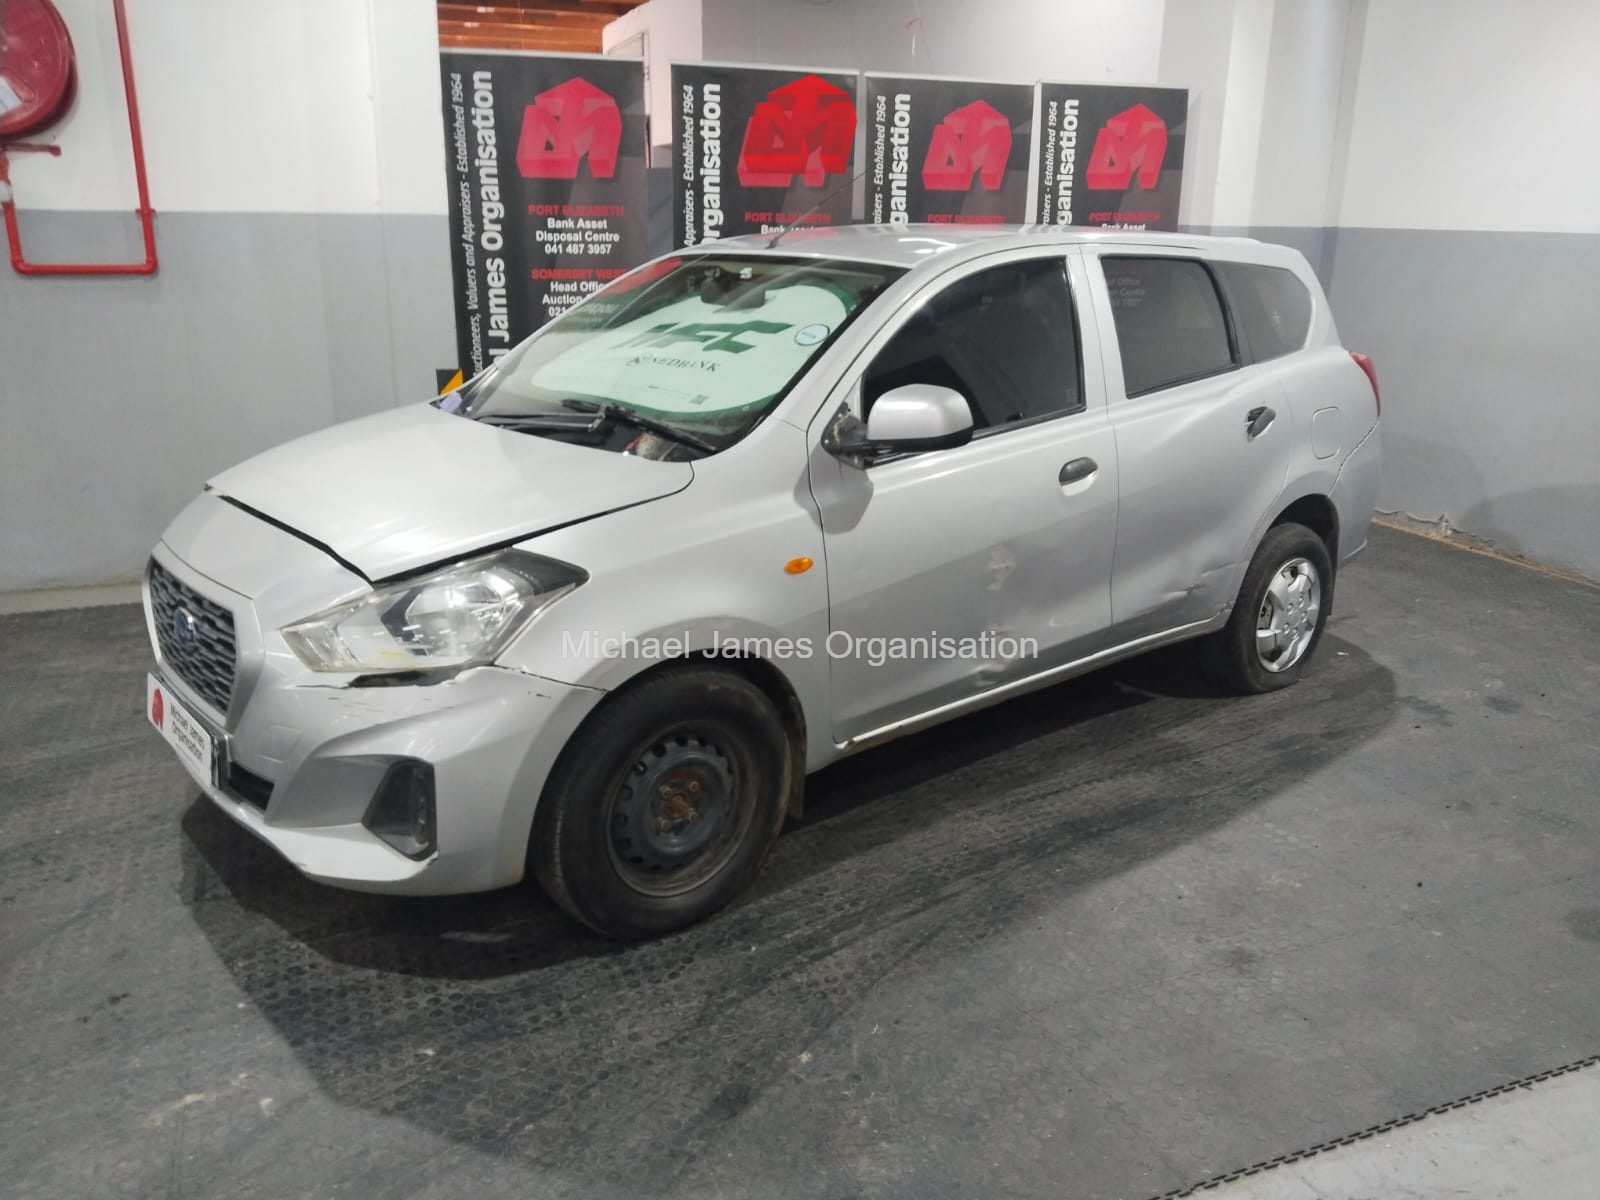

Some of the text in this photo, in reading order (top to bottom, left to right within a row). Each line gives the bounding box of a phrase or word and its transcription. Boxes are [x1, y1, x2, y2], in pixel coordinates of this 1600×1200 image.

[450, 72, 463, 103] 1964
[682, 84, 694, 114] 1964
[876, 95, 887, 122] 1964
[1048, 100, 1058, 126] 1964
[452, 104, 469, 173] Established
[682, 115, 695, 181] Established
[471, 70, 505, 251] Organisation
[874, 124, 886, 185] Established
[889, 93, 911, 225] ganisation
[1044, 128, 1056, 186] Established
[1056, 99, 1079, 225] ganisation
[459, 181, 476, 243] Appraisers
[528, 204, 559, 216] PORT
[547, 217, 608, 229] Bank Asset
[744, 211, 772, 223] PORT
[872, 192, 883, 224] aisers
[535, 230, 620, 243] Disposal Centre
[544, 243, 613, 255] 041 487 3957
[462, 242, 475, 267] and
[466, 268, 479, 310] Valuers
[486, 257, 510, 343] James
[542, 294, 583, 305] Auction
[550, 281, 577, 292] Head
[471, 313, 483, 378] uctioneers,
